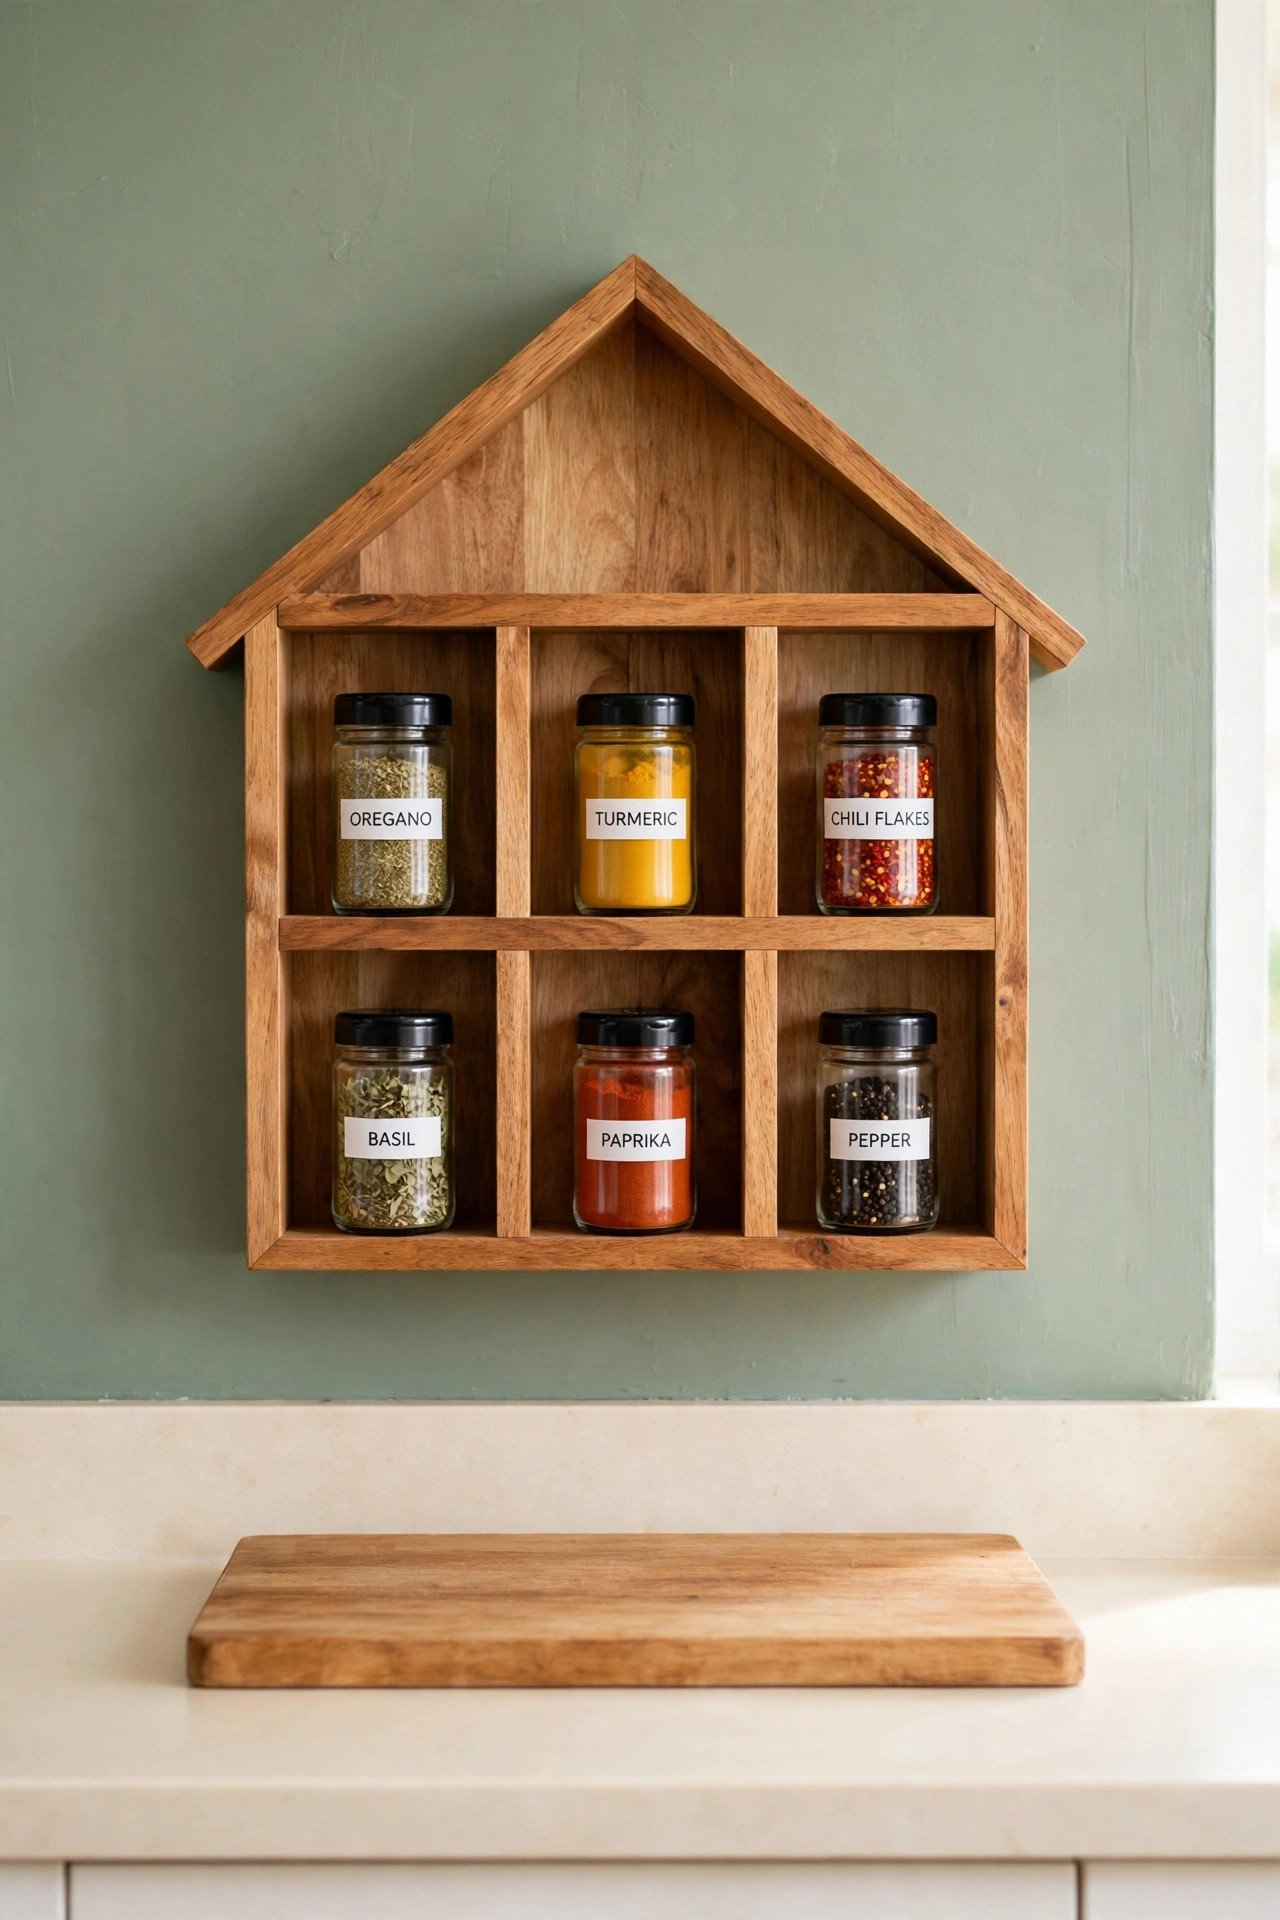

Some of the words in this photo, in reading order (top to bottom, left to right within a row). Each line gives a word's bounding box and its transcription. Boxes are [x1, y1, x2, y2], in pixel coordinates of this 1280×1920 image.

[349, 811, 432, 827] OREGANO
[594, 811, 678, 827] TURMERIC
[830, 811, 869, 826] CHILI
[875, 811, 930, 826] FLAKES
[368, 1131, 416, 1147] BASIL
[601, 1132, 672, 1148] PAPRIKA
[848, 1132, 912, 1148] PEPPER
